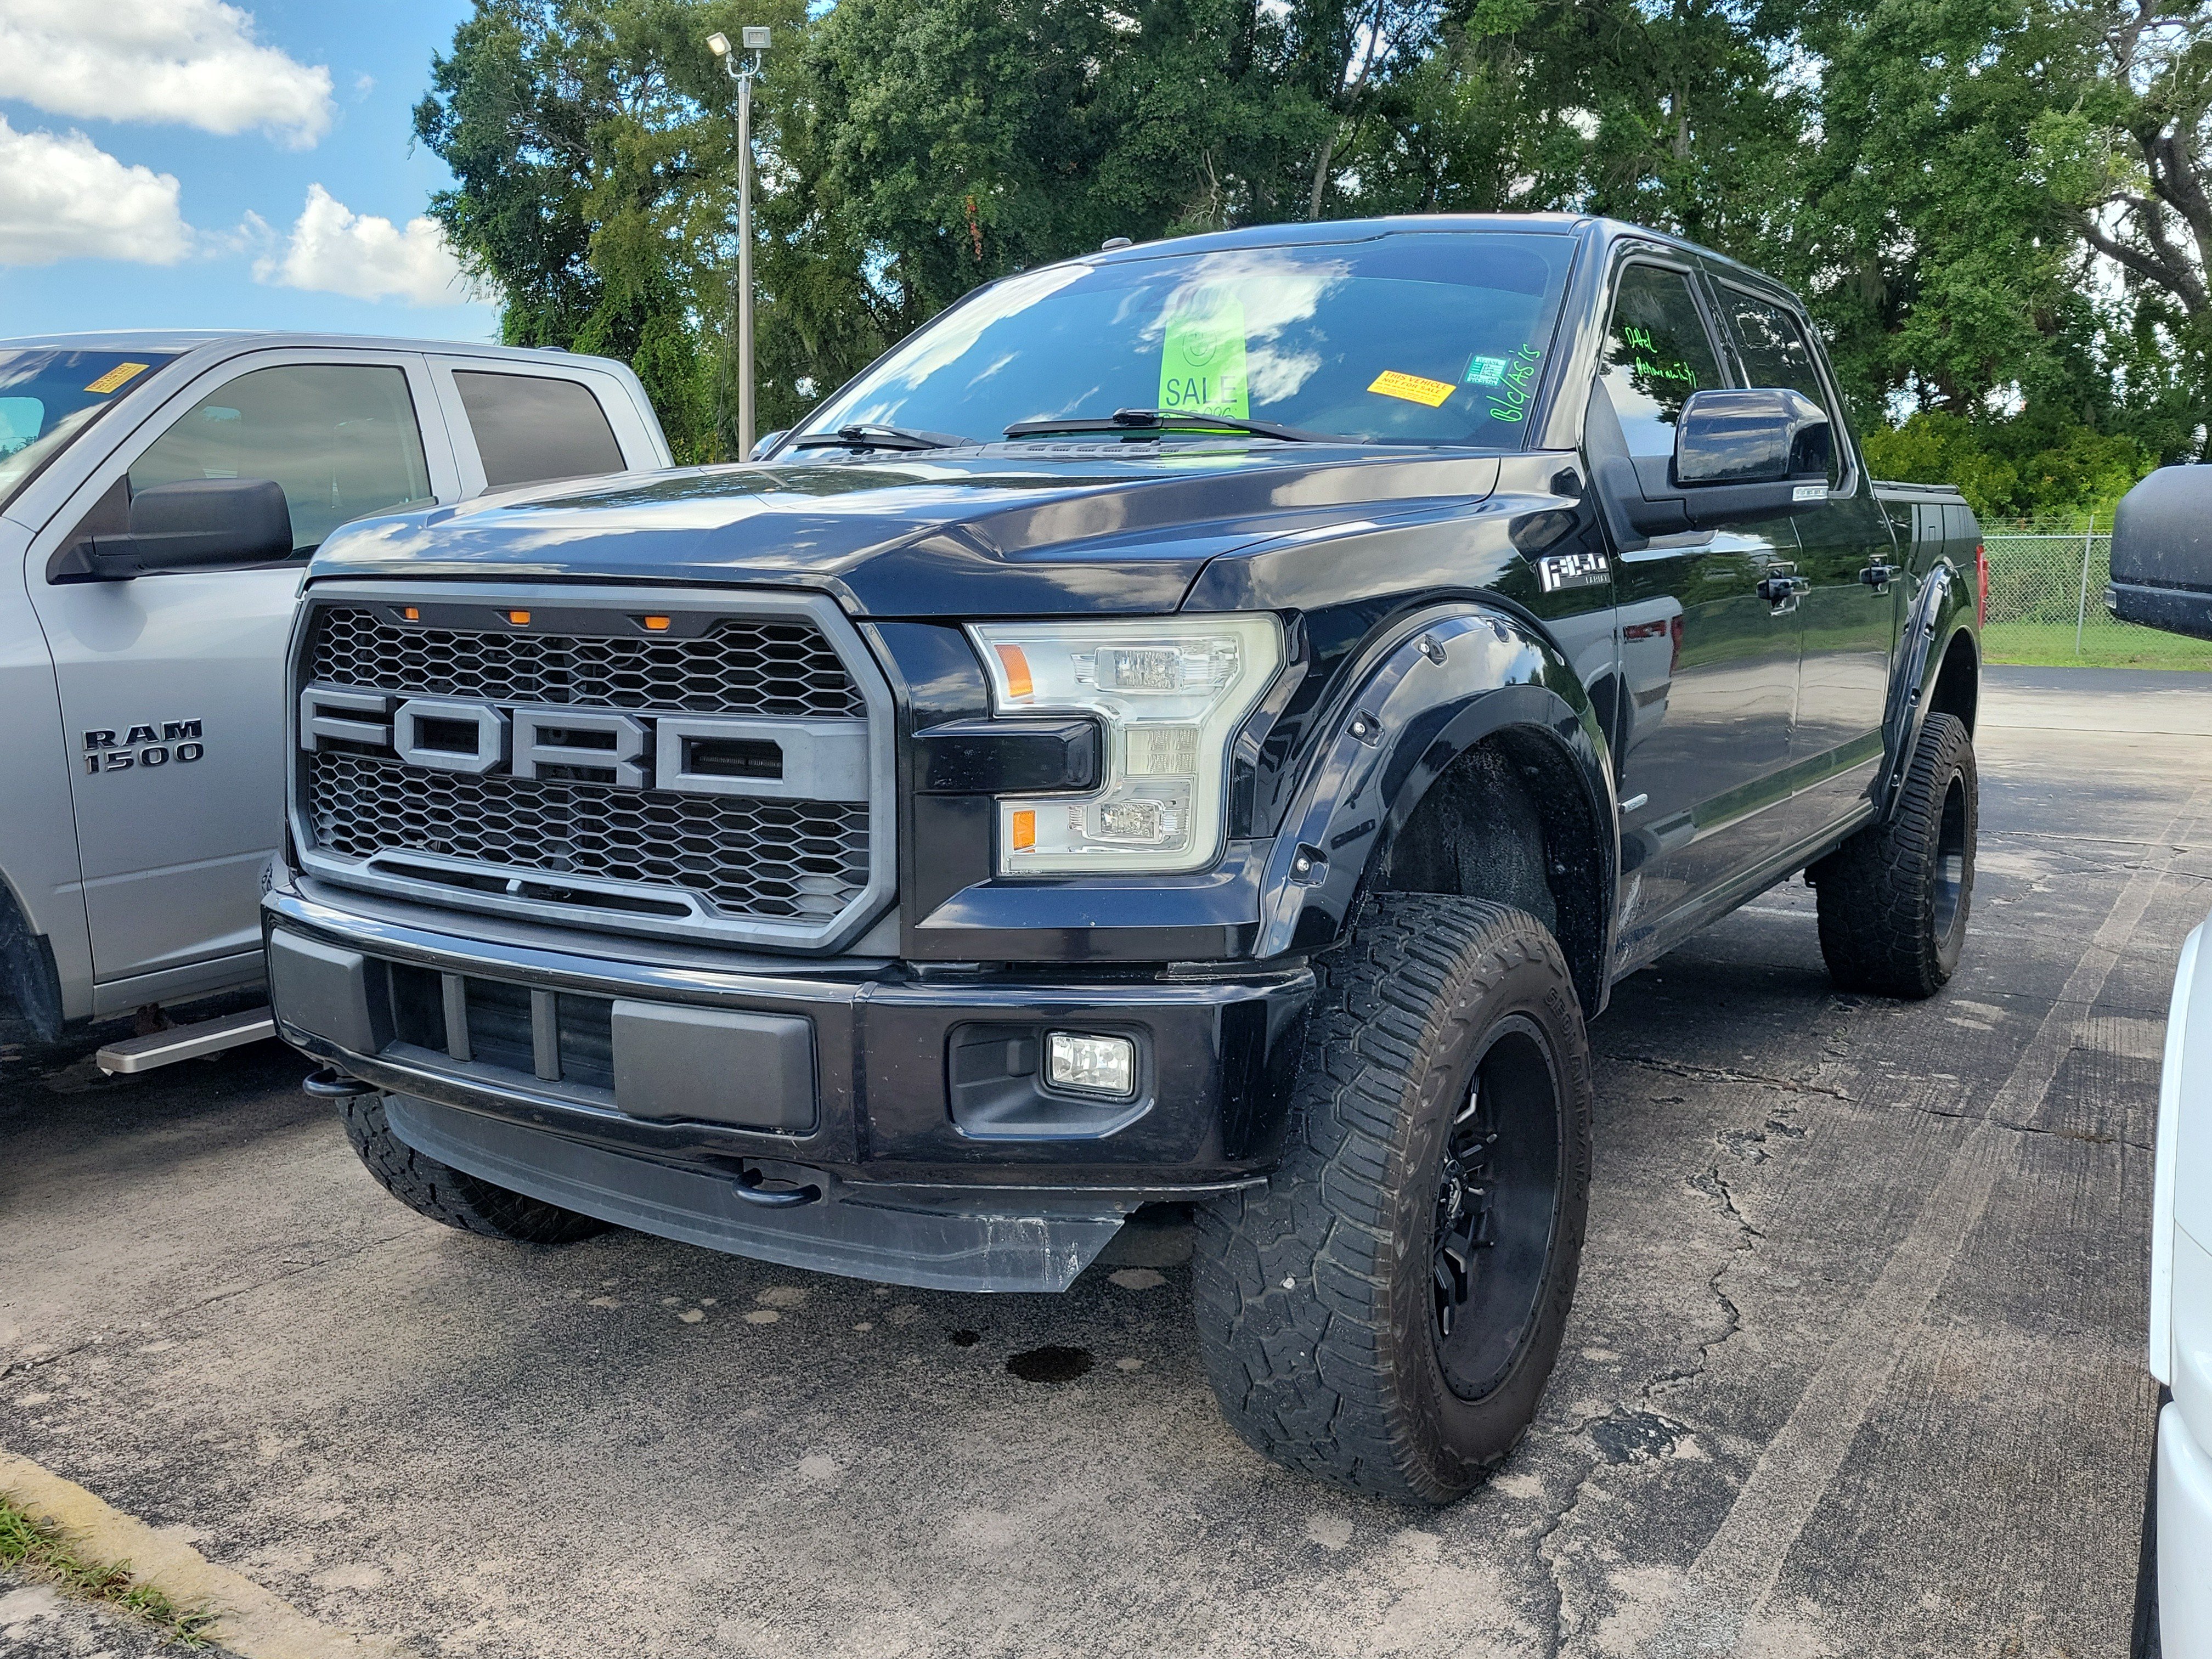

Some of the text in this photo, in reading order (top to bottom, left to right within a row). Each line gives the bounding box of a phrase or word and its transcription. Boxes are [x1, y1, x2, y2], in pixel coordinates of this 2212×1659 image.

[1166, 376, 1238, 407] SALE
[1385, 372, 1449, 391] THIS VEHICLE
[1401, 381, 1419, 389] FOR
[1420, 386, 1442, 394] SALE
[82, 718, 203, 751] RAM
[300, 681, 869, 803] FORD
[83, 741, 204, 775] 1500
